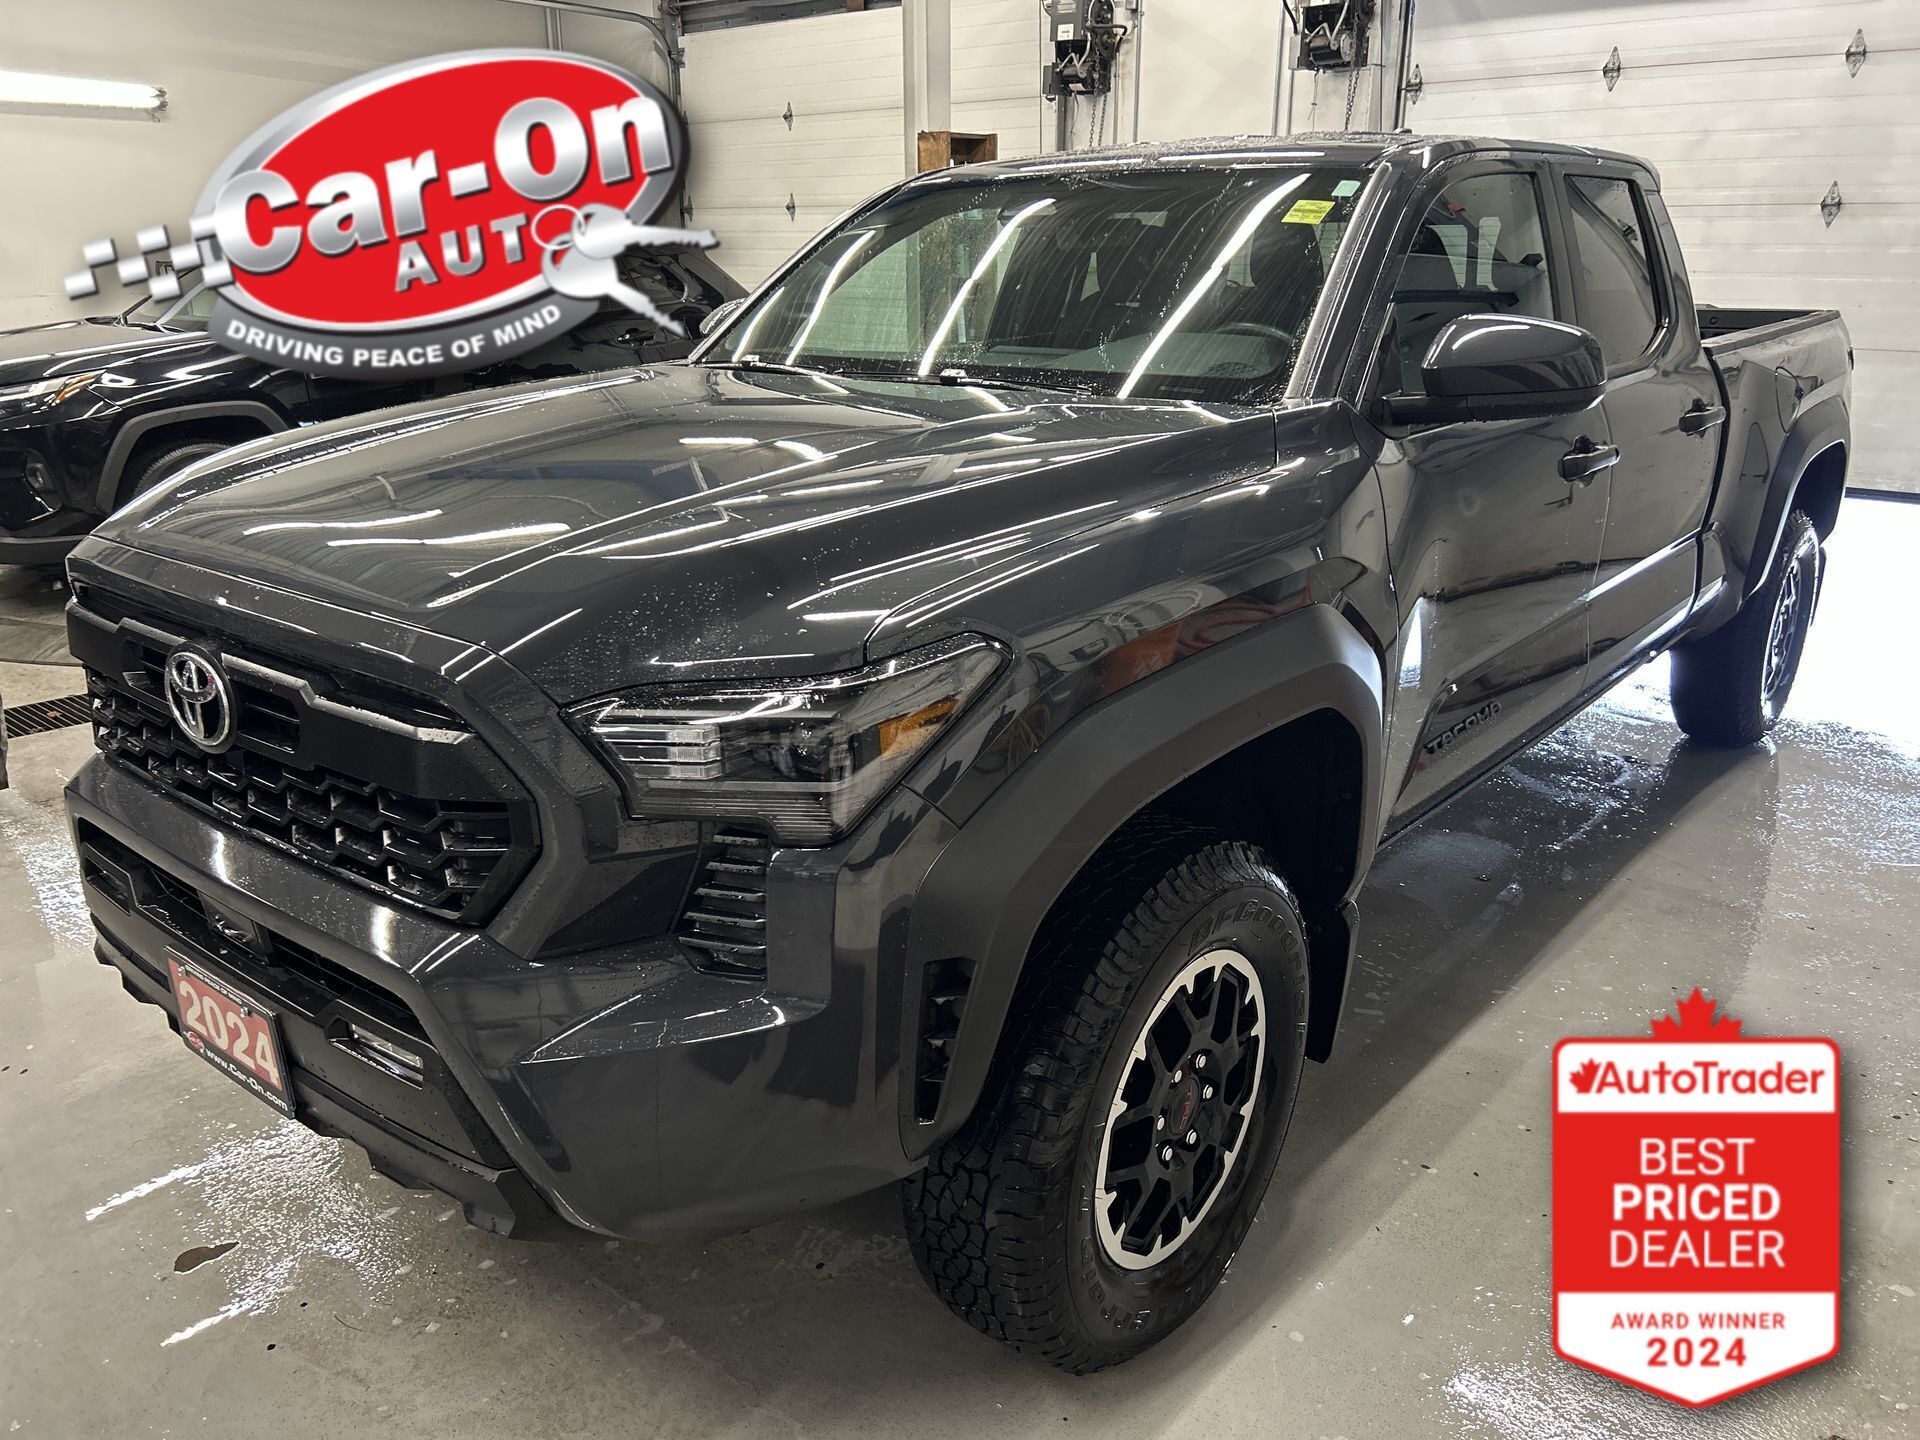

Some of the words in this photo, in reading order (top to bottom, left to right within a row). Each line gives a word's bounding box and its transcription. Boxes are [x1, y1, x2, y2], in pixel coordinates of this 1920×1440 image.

[1424, 700, 1502, 754] TACOMA
[178, 979, 281, 1088] 2024
[205, 1048, 289, 1112] www.Car-On.com
